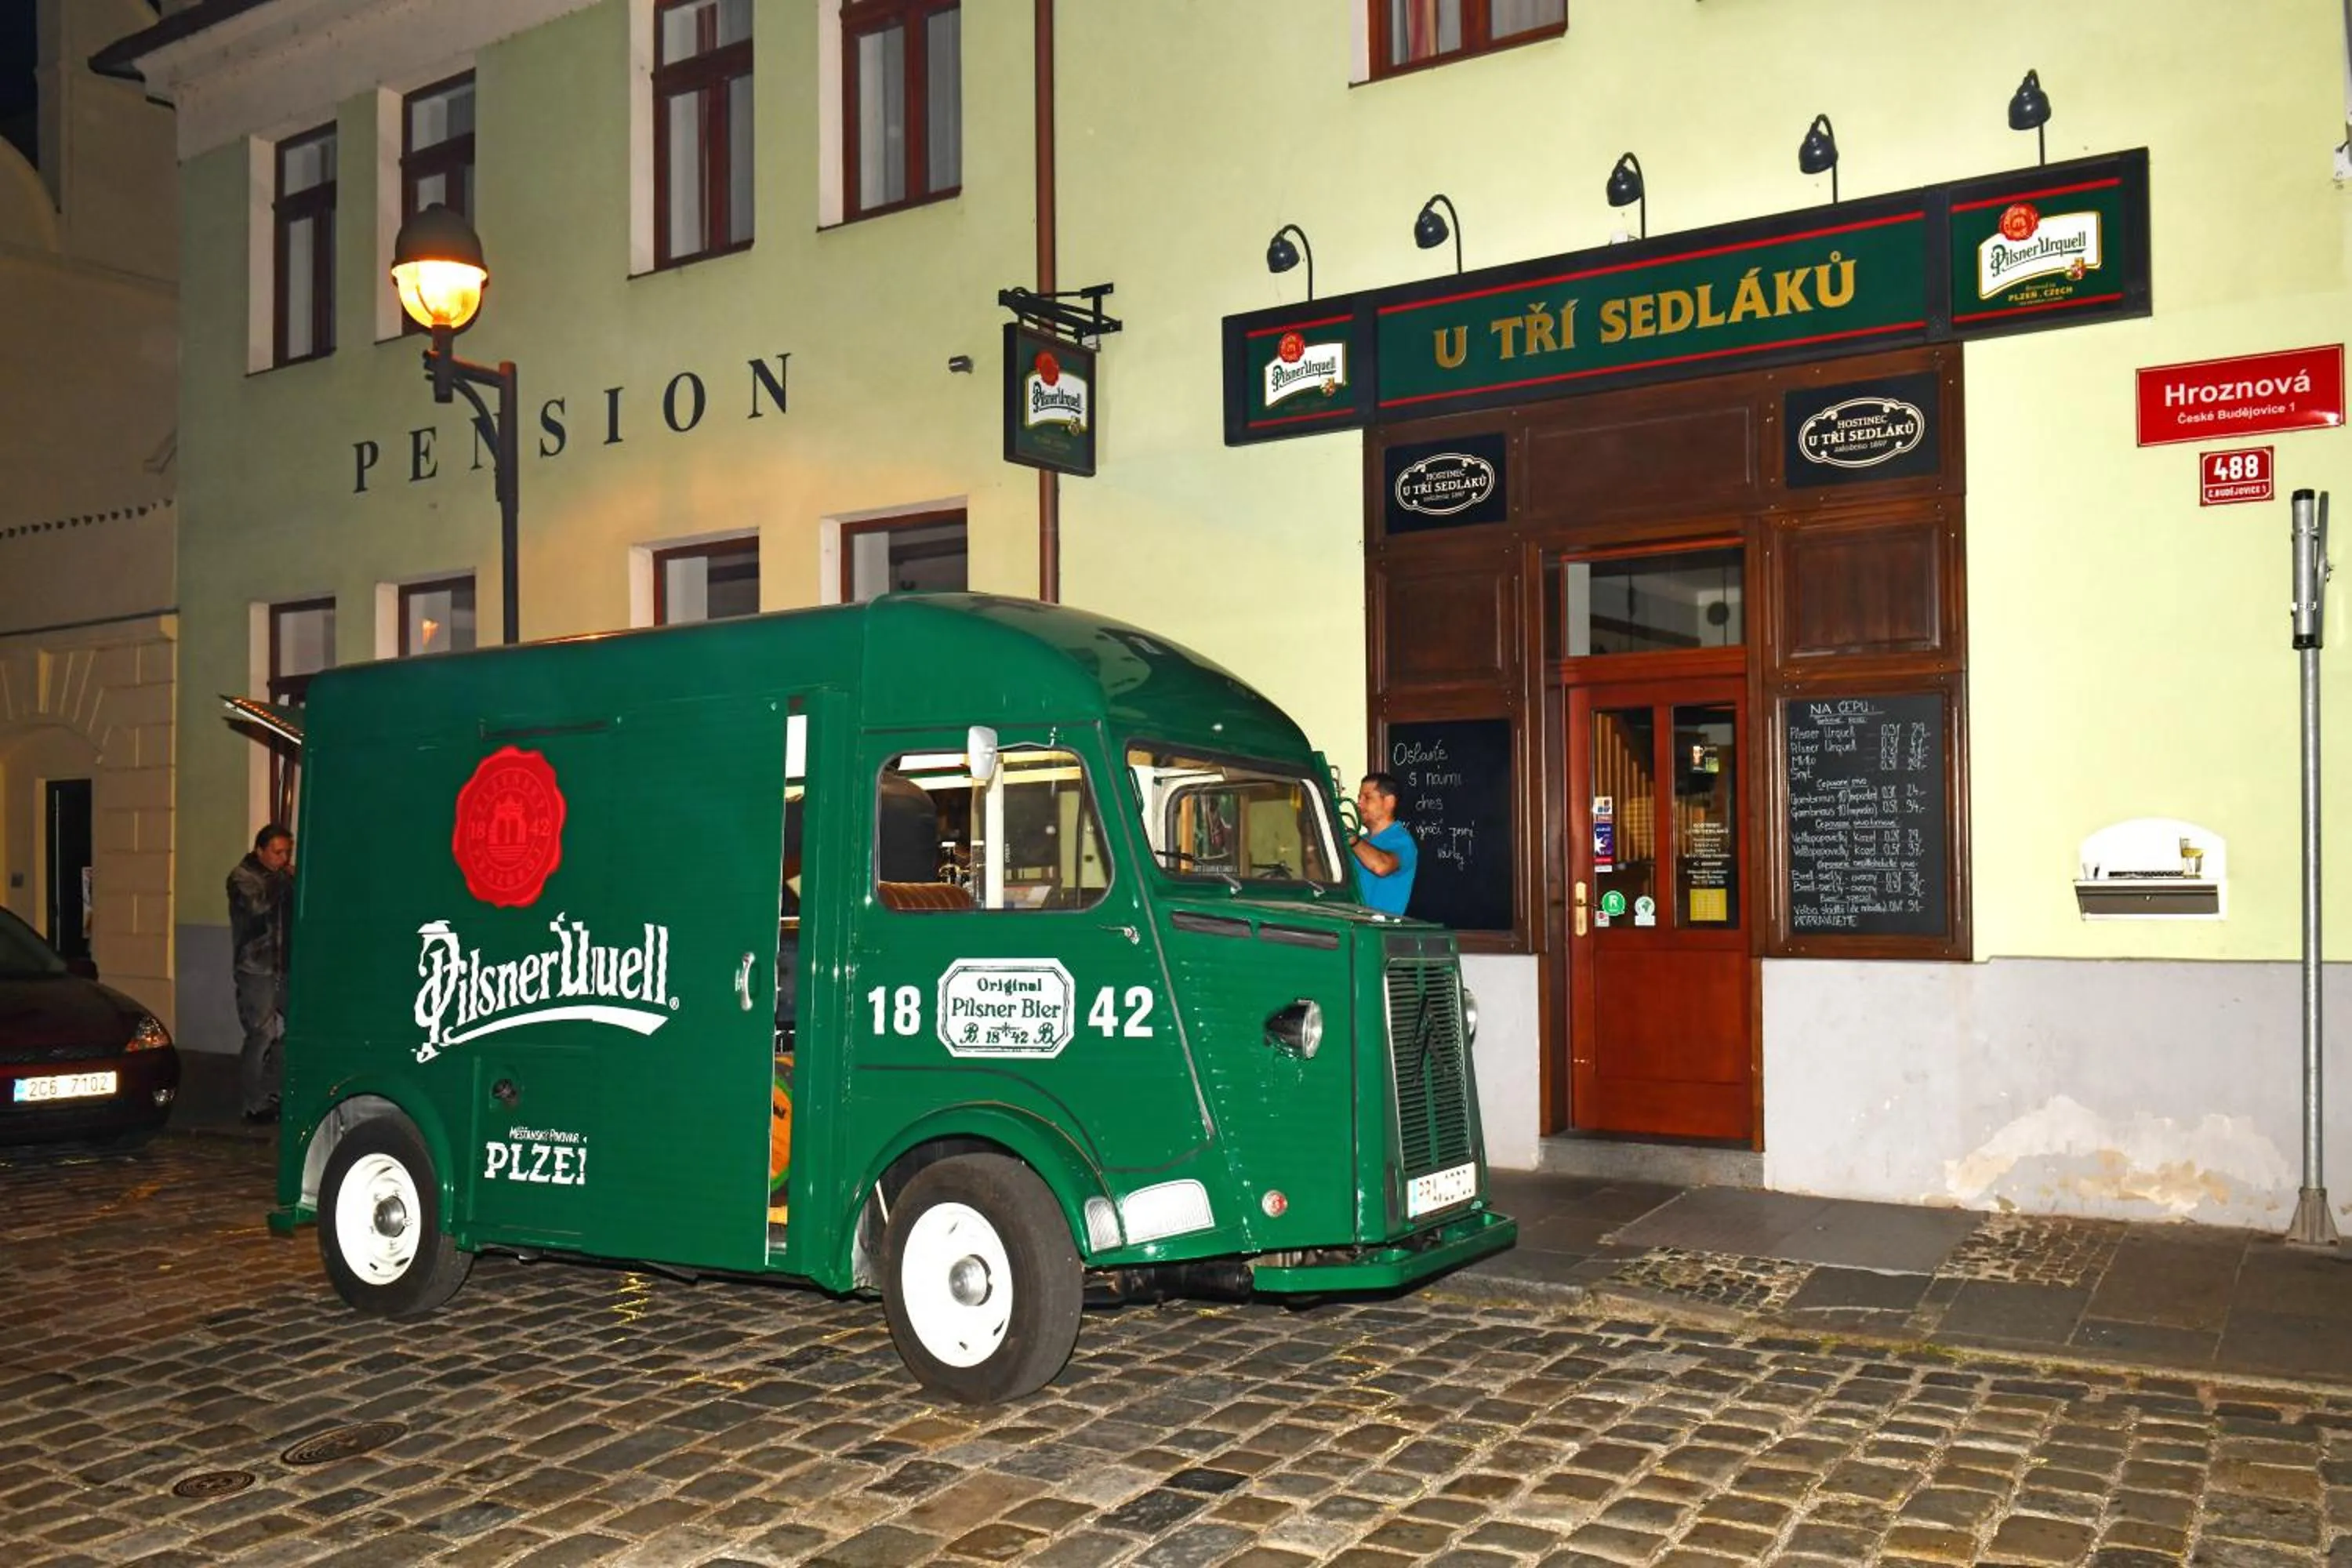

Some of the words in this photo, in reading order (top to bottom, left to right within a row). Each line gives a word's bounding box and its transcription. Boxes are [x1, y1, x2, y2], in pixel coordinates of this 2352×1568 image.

[1991, 244, 2038, 278] Pilsner
[2038, 230, 2087, 257] Urquell
[1434, 325, 1469, 369] U
[1490, 299, 1580, 360] TŘÍ
[1600, 250, 1857, 344] SEDLÁKŮ
[1271, 365, 1305, 392] Pilsner
[2165, 368, 2311, 407] Hroznová
[1837, 415, 1888, 429] HOSTINEC
[2177, 411, 2214, 424] České
[2217, 404, 2286, 419] Budějovice
[2288, 401, 2296, 412] 1
[1809, 435, 1818, 446] U
[1822, 431, 1845, 445] TŘÍ
[1849, 421, 1915, 441] SEDLÁKŮ
[2213, 454, 2259, 481] 488
[1403, 486, 1410, 496] U
[1413, 481, 1432, 495] TŘÍ
[1434, 474, 1487, 492] SEDLÁKŮ
[1810, 702, 1832, 714] NA
[1415, 794, 1444, 811] dnes
[410, 920, 559, 1064] Pilsner
[978, 977, 1042, 996] Original
[868, 985, 921, 1036] 18
[951, 997, 1017, 1019] Pilsner
[1021, 998, 1062, 1019] Bier
[1087, 985, 1154, 1038] 42
[985, 1030, 1000, 1044] 18
[71, 1075, 108, 1094] 7102
